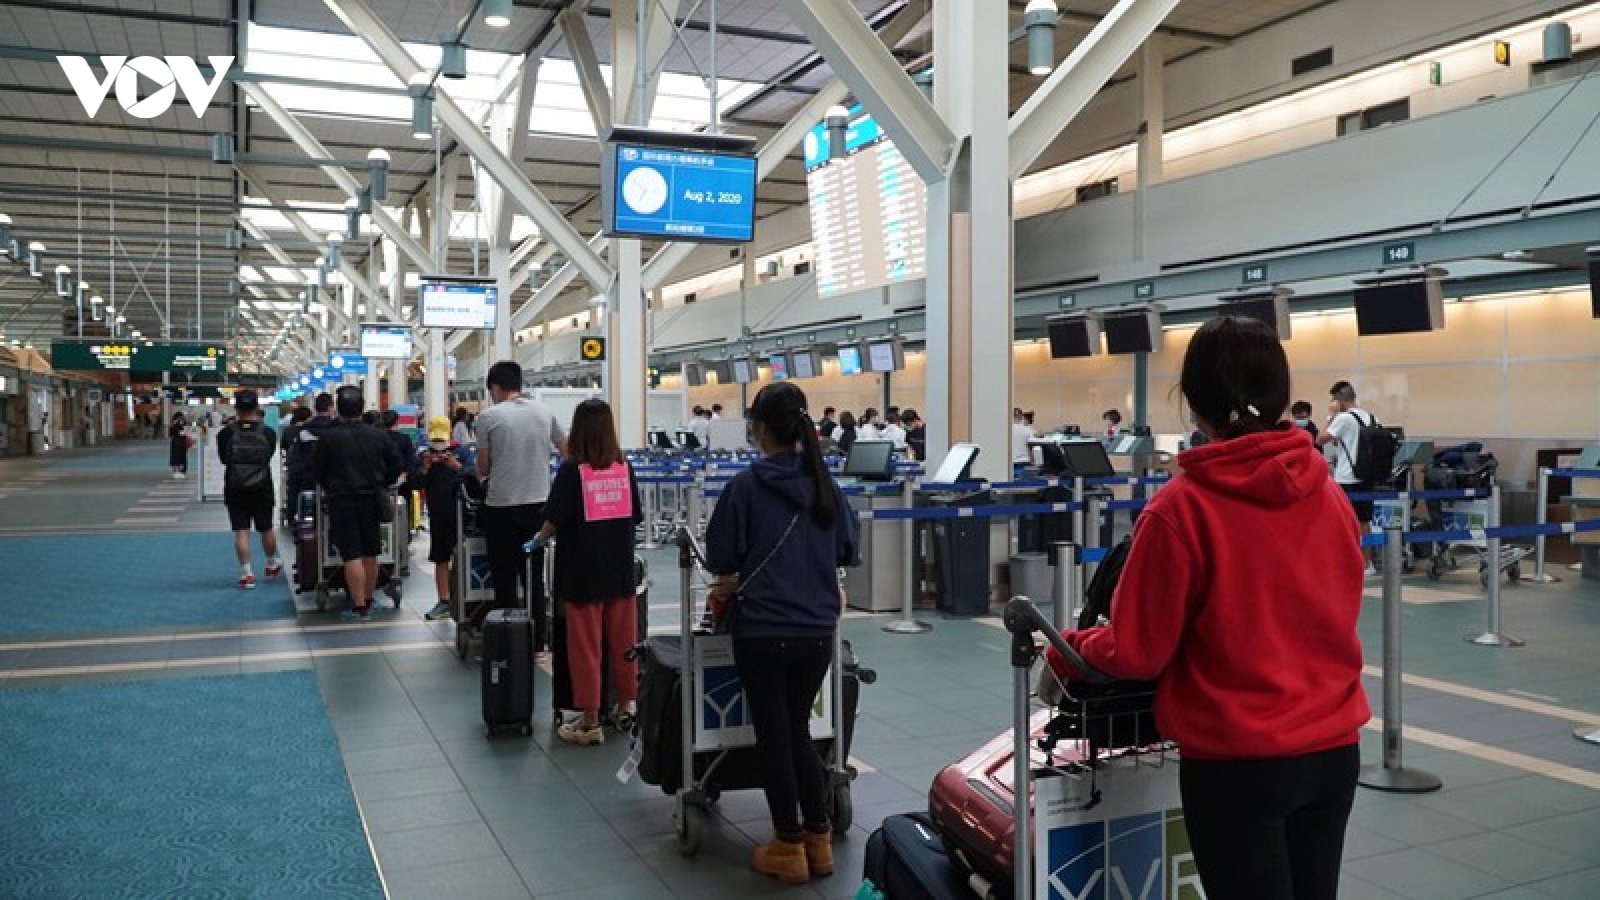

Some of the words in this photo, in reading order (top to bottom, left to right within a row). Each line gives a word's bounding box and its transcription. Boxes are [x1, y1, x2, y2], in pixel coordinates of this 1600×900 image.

[684, 189, 703, 204] Aug
[705, 190, 714, 204] 2,
[717, 191, 742, 205] 2020
